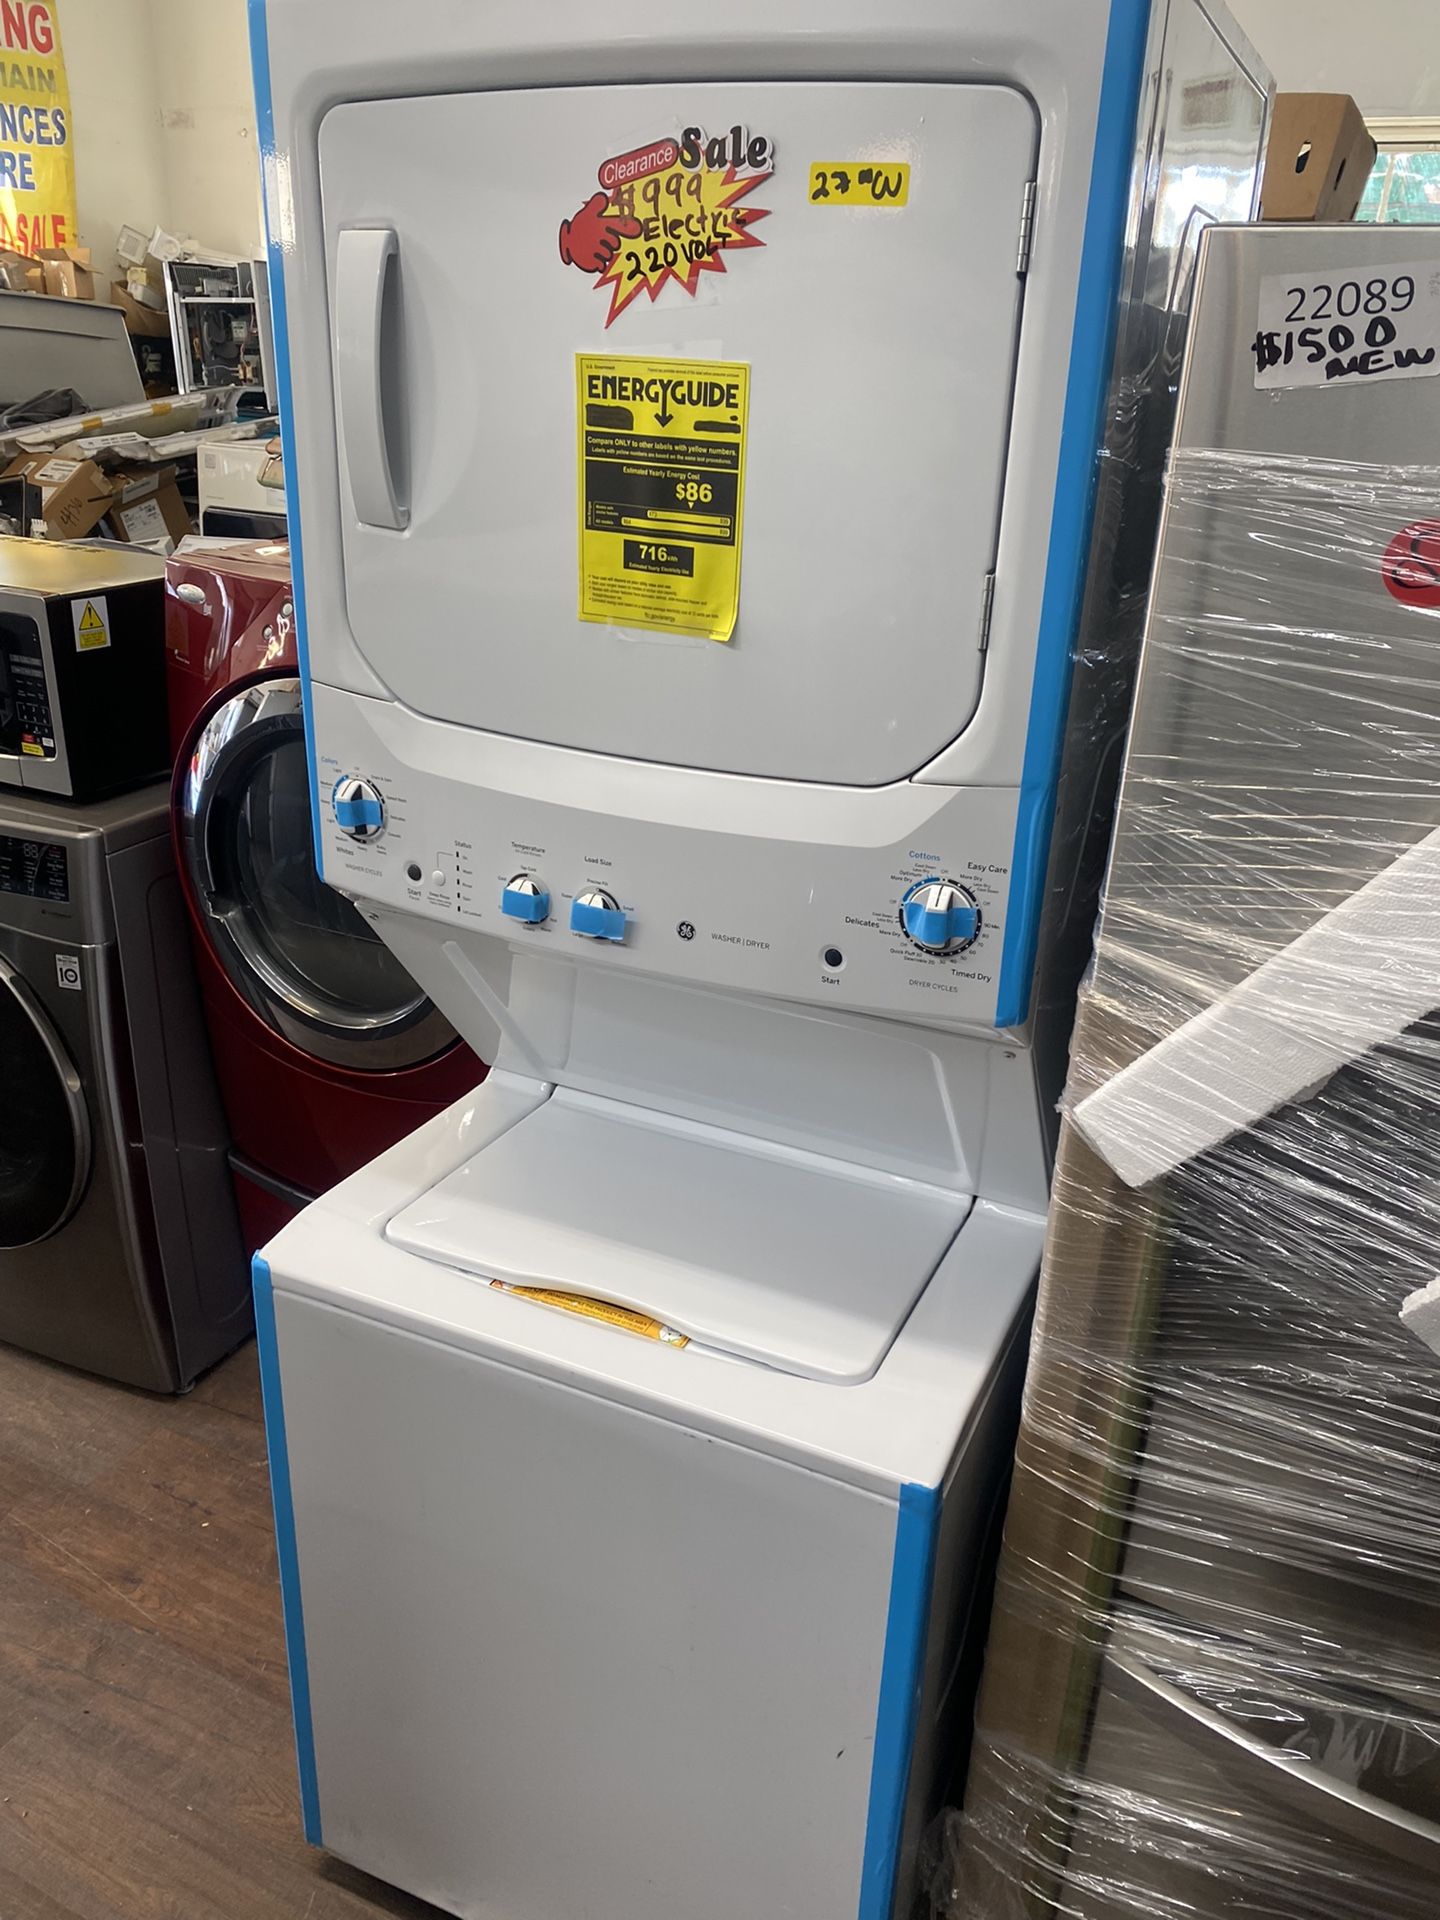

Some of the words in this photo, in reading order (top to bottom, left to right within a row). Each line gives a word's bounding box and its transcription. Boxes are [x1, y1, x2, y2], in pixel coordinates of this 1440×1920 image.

[0, 0, 54, 54] NG
[679, 125, 768, 170] Sale
[604, 145, 673, 184] Clearance
[626, 242, 679, 281] 220
[1285, 276, 1415, 322] 22089
[1251, 316, 1396, 373] $1500
[1325, 347, 1436, 380] NEW
[587, 436, 613, 446] Compare
[614, 438, 631, 447] ONLY
[631, 440, 638, 448] to
[639, 441, 654, 450] other
[655, 442, 673, 451] labels
[688, 445, 708, 454] yellow
[623, 466, 649, 476] Estimated
[649, 468, 666, 479] Yearly
[666, 470, 686, 480] Energy
[687, 472, 700, 480] Cost
[675, 481, 713, 503] $86
[639, 544, 668, 562] 716
[511, 842, 545, 854] Temperature
[909, 850, 941, 862] Cottons
[584, 855, 599, 865] Load
[600, 858, 612, 867] Size
[967, 861, 987, 873] Easy
[988, 864, 1009, 875] Care
[845, 916, 880, 929] Delicates
[711, 932, 742, 945] WASHER
[746, 939, 770, 950] DRYER
[821, 975, 841, 986] Start
[951, 968, 976, 980] Timed
[977, 972, 993, 983] Dry
[908, 979, 931, 989] DRYER
[931, 983, 959, 994] CYCLES
